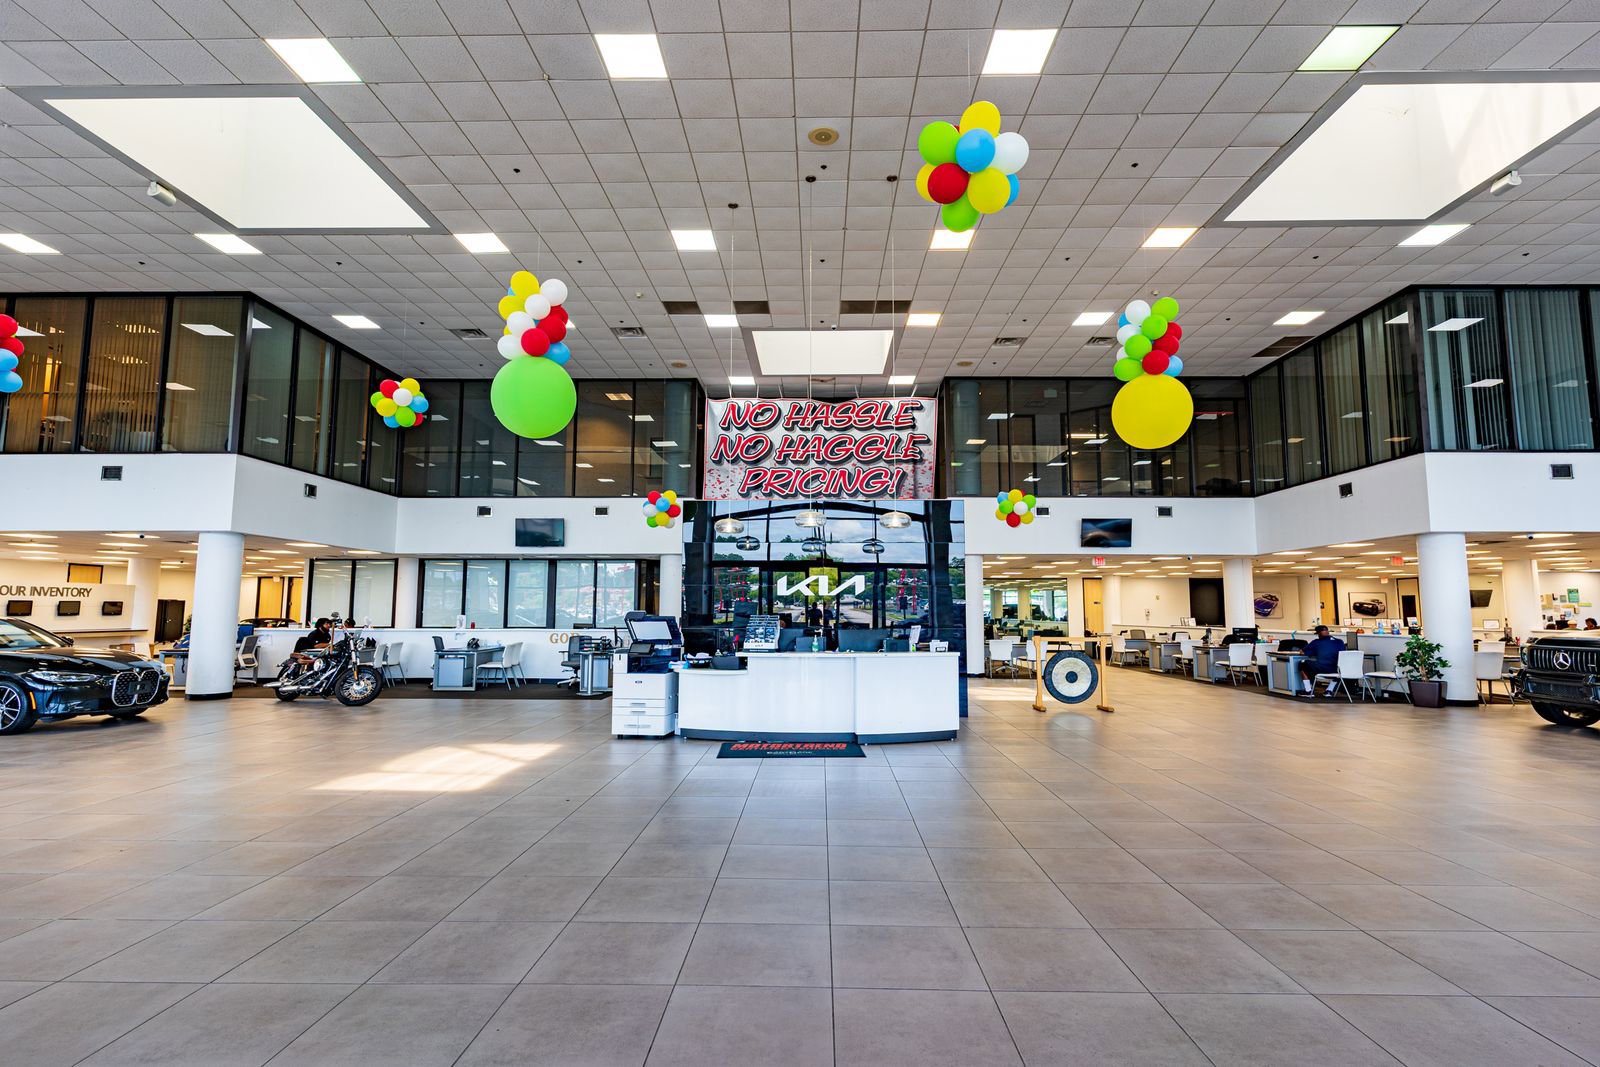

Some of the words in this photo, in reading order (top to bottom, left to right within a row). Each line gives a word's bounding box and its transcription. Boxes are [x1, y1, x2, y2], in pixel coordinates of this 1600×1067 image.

[719, 401, 780, 429] NO
[783, 401, 923, 429] HASSLE
[710, 433, 773, 463] NO
[775, 433, 929, 463] HAGGLE
[738, 466, 906, 496] PRICING!
[0, 585, 26, 596] OUR
[30, 586, 92, 597] INVENTORY
[777, 575, 865, 596] KIA
